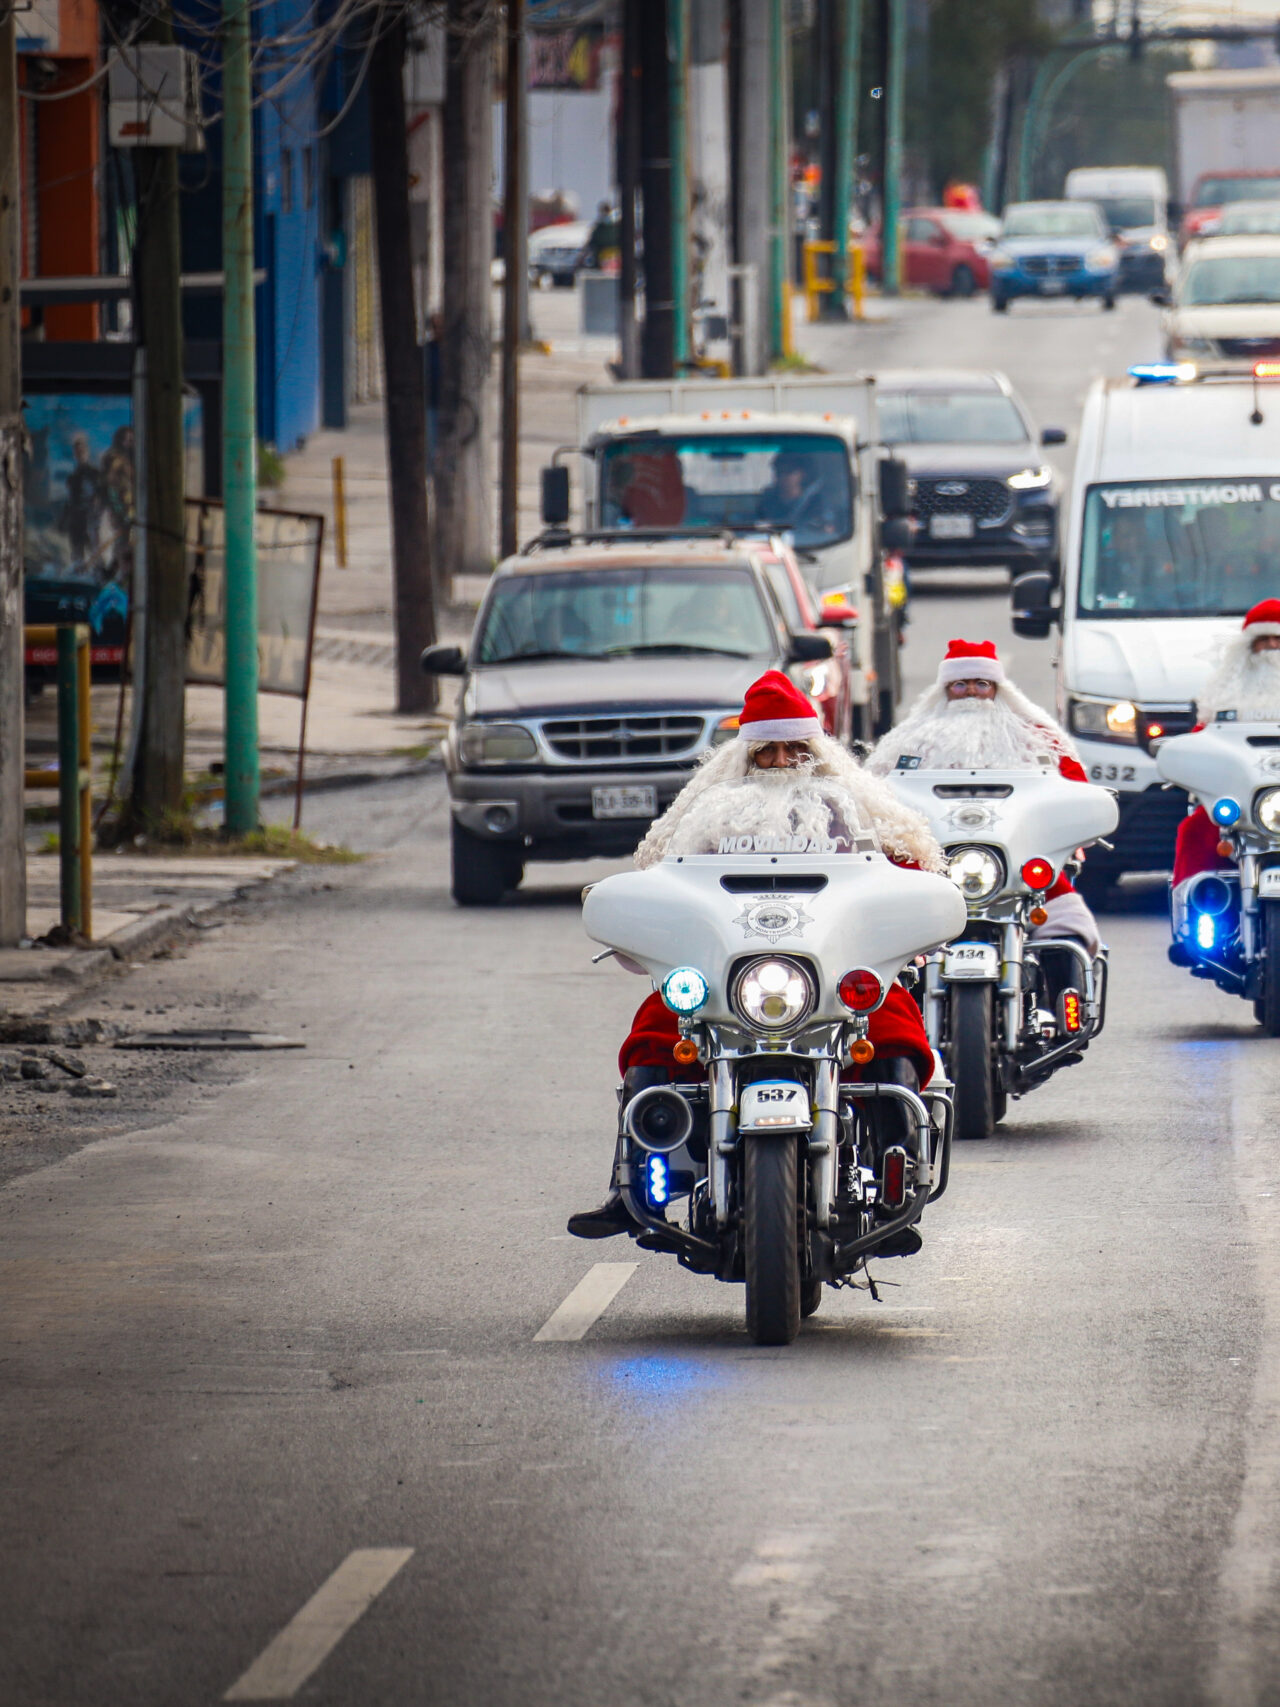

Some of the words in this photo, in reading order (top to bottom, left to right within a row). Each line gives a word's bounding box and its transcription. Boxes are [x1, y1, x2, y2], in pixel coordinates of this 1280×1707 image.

[1091, 765, 1135, 781] 632
[718, 834, 838, 853] MOVILIDAD
[956, 949, 985, 960] 434
[757, 1088, 797, 1103] 537
